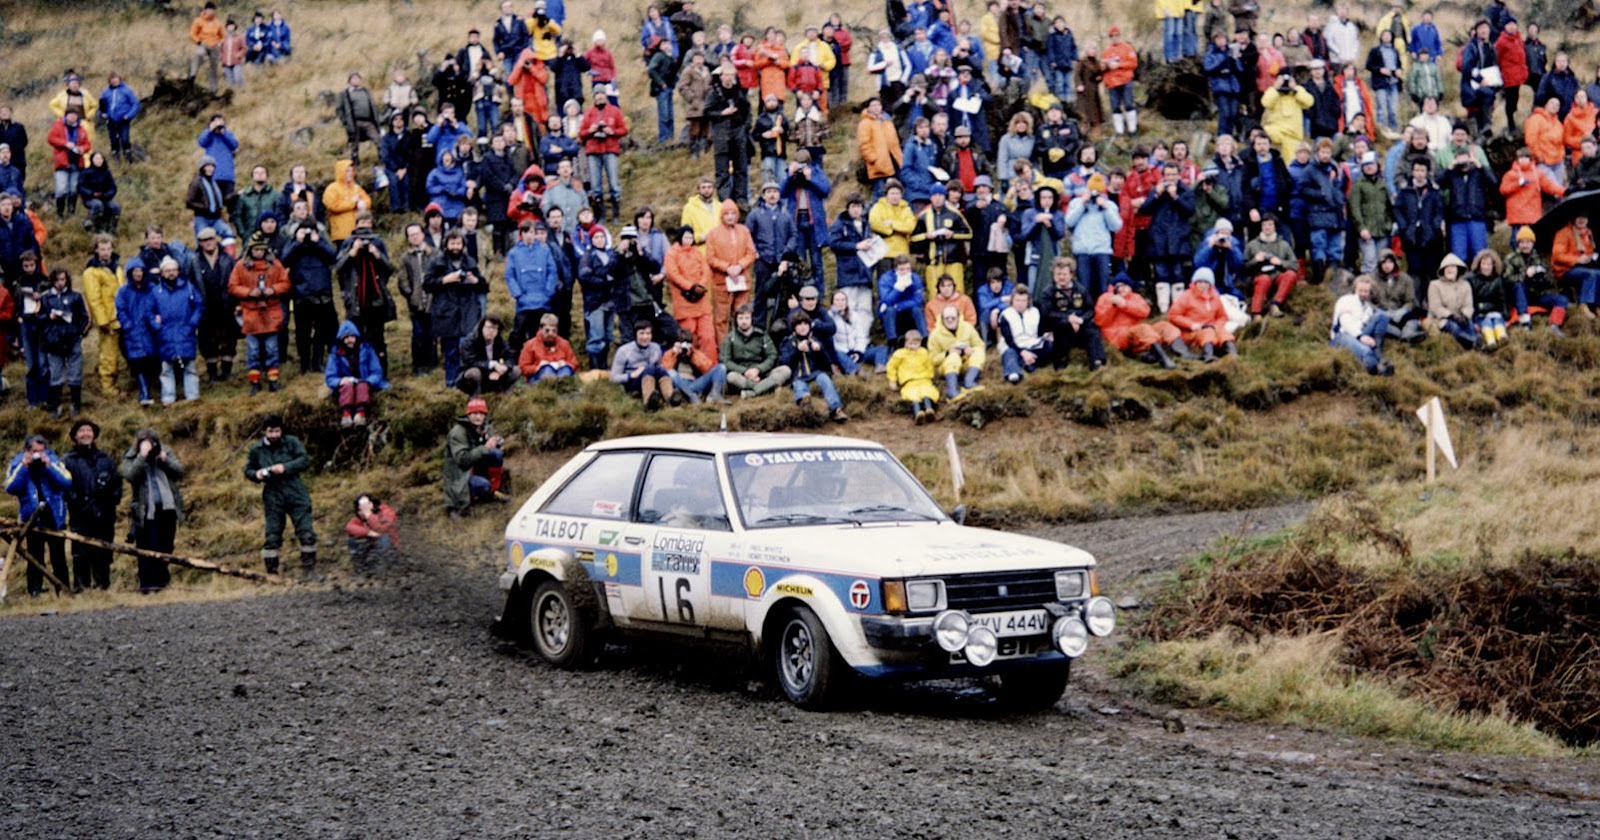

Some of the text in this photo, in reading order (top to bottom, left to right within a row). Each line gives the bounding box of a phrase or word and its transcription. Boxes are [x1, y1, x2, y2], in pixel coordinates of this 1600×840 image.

[763, 450, 888, 464] TALBOT SUNBEAM
[536, 518, 588, 540] TALBOT
[653, 530, 706, 553] Lombard
[666, 554, 700, 573] rally
[777, 583, 813, 596] MICHELIN
[658, 576, 696, 624] 16
[1006, 613, 1046, 632] 444V
